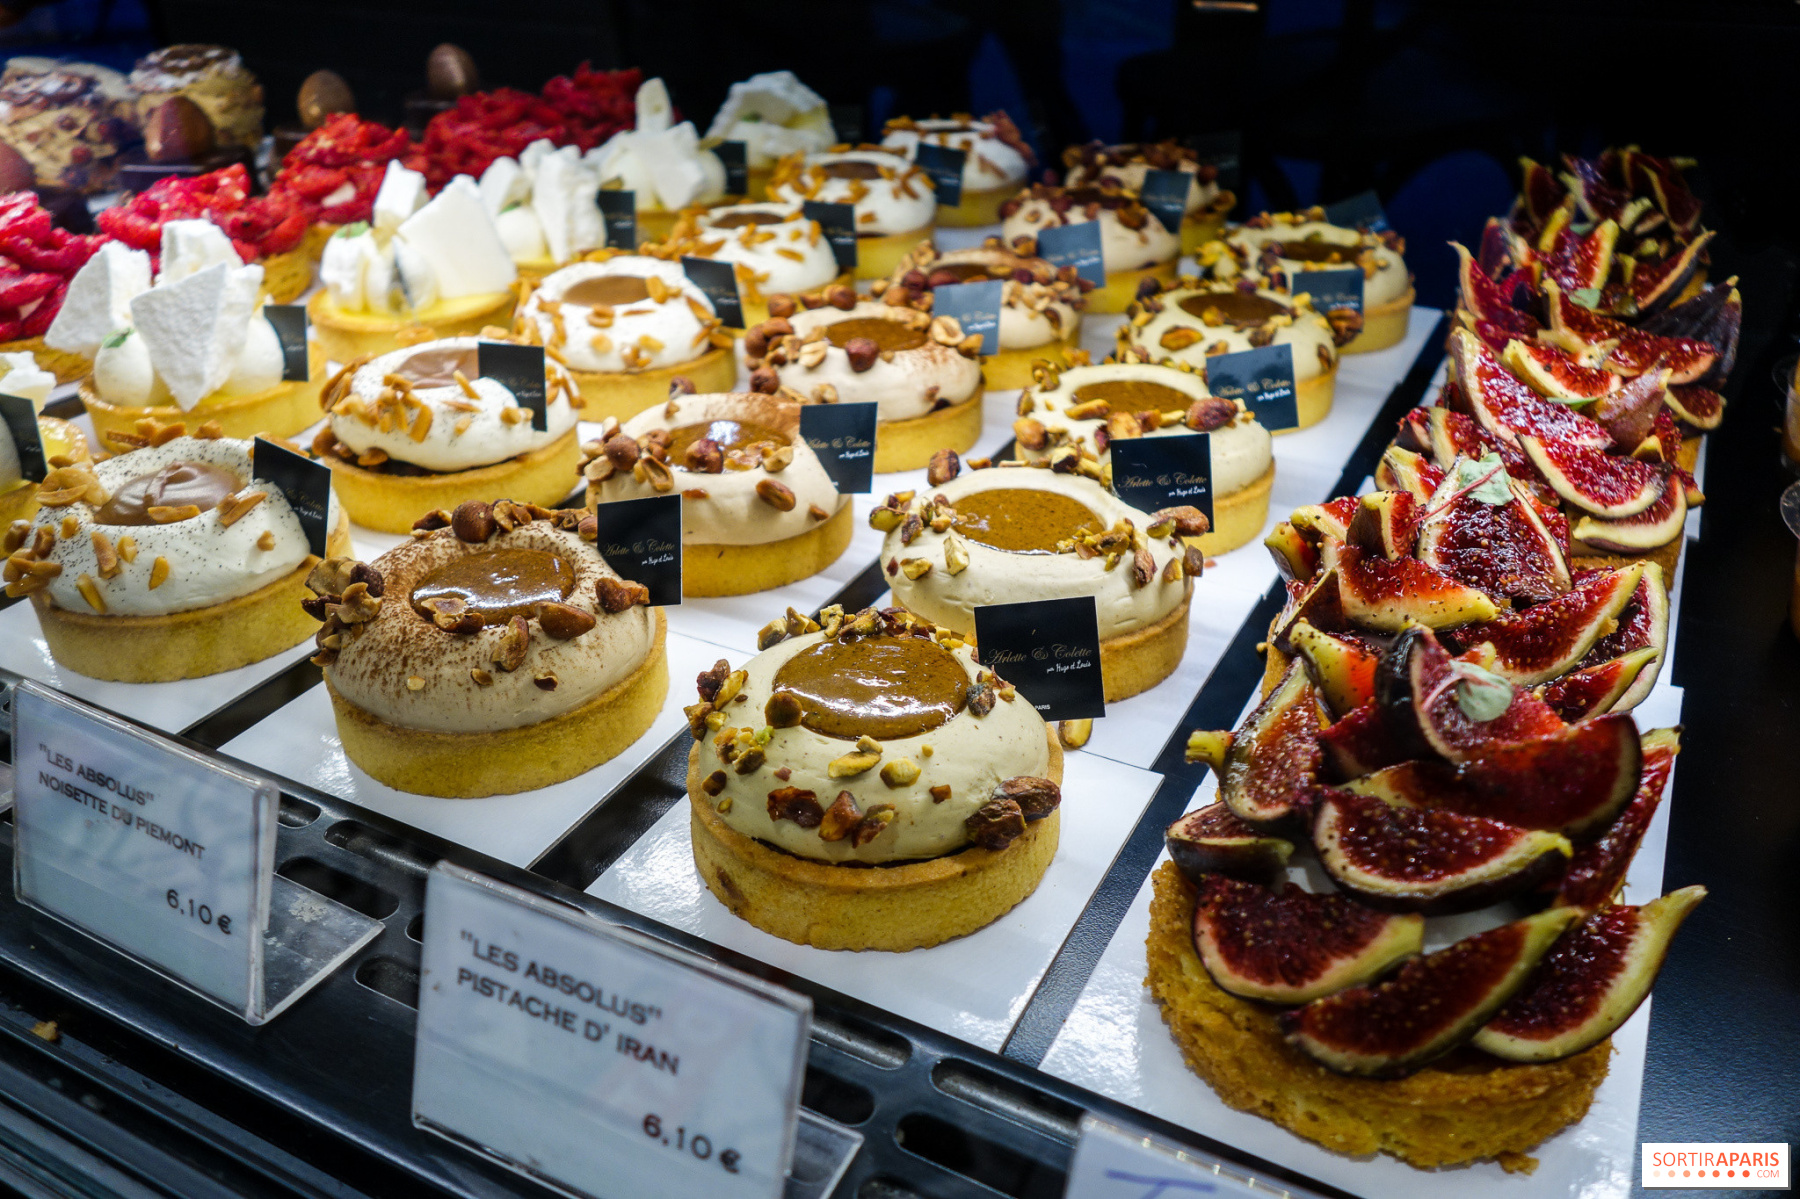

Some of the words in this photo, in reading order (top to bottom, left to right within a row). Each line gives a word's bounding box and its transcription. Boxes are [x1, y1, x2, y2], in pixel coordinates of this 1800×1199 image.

[984, 649, 1027, 665] Arlette
[1031, 645, 1049, 661] &
[1051, 643, 1092, 660] Colette
[39, 743, 73, 773] "LES
[76, 763, 155, 806] ABSOLUS"
[39, 771, 109, 816] NOISETTE
[112, 804, 134, 826] DU
[136, 816, 206, 860] PIEMONT
[456, 966, 578, 1034] PISTACHE
[615, 1033, 681, 1077] IRAN
[460, 928, 519, 973] "LES
[523, 960, 663, 1026] ABSOLUS"
